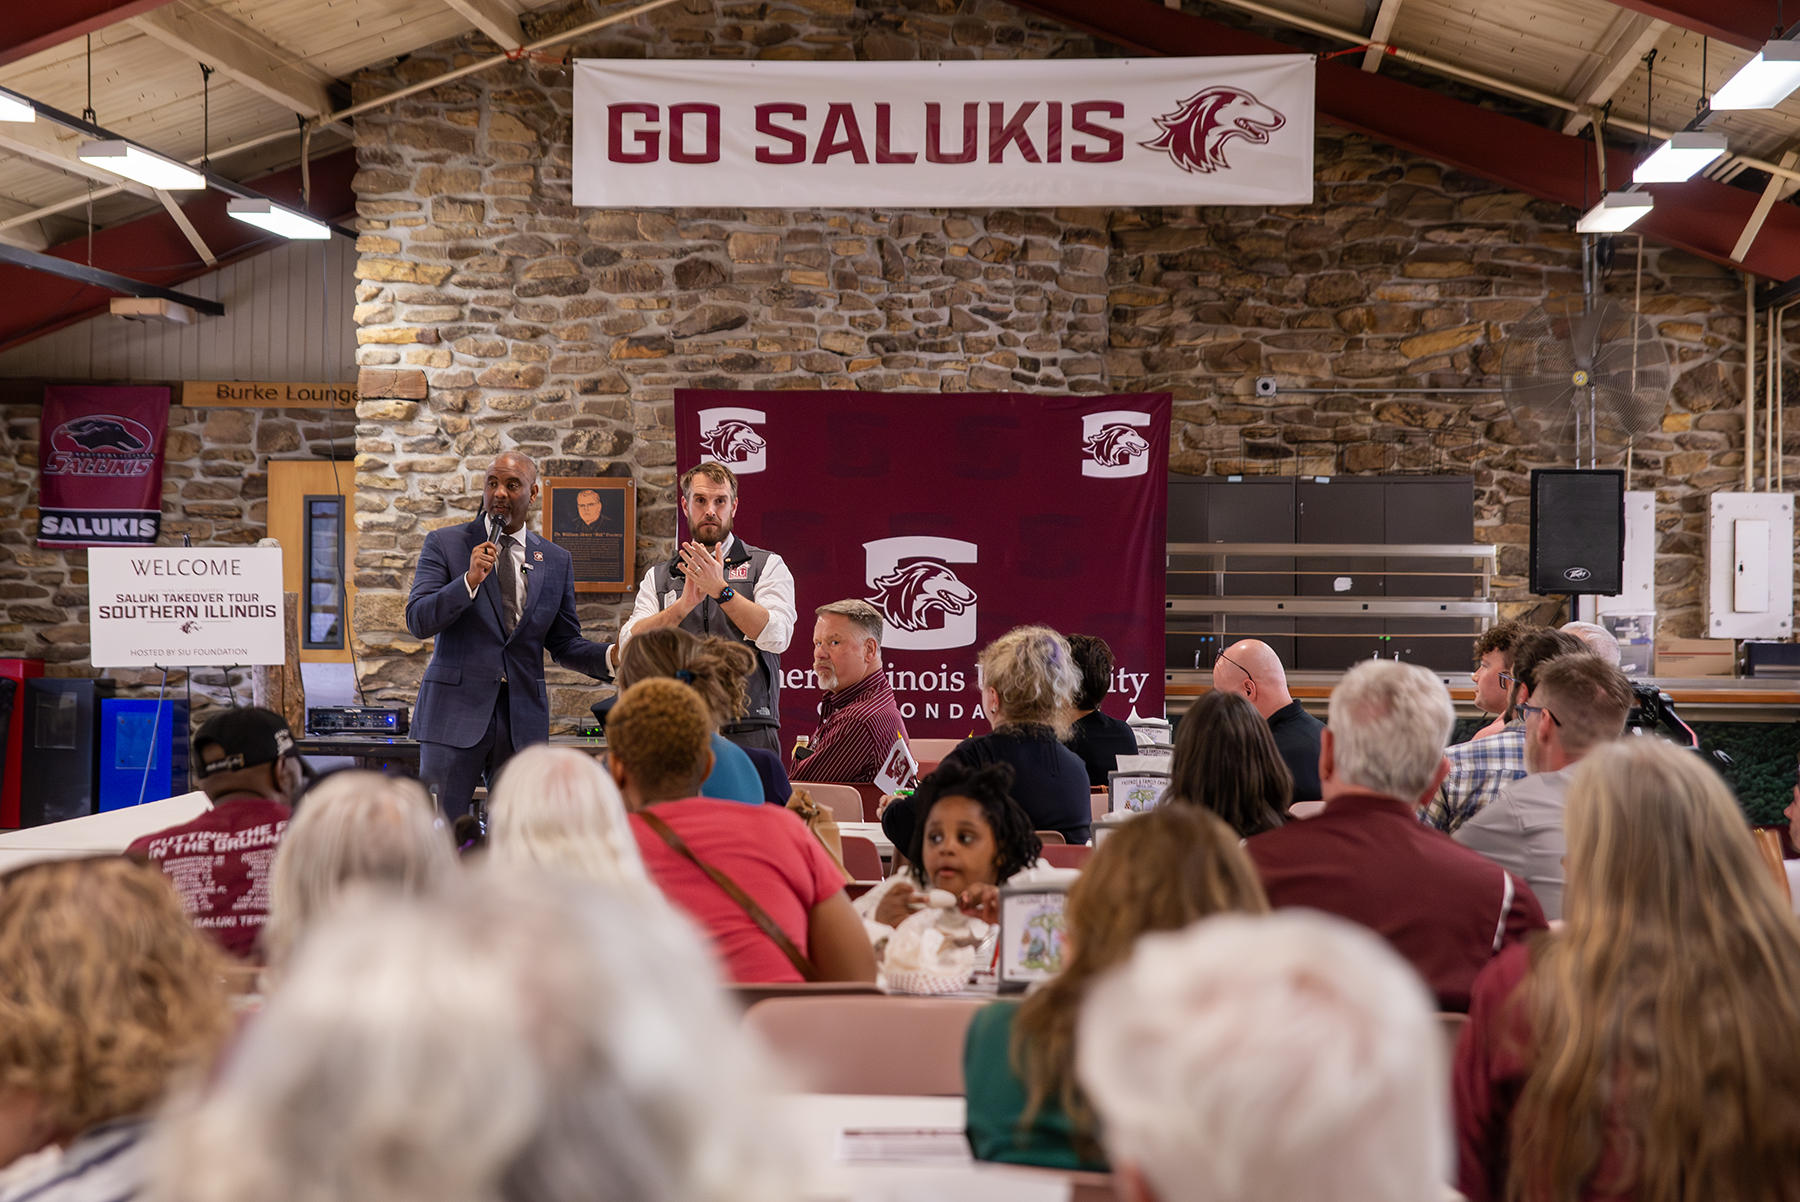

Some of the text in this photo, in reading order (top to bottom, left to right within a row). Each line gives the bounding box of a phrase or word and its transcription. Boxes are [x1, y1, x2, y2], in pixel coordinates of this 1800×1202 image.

[606, 101, 1126, 165] GO SALUKIS
[216, 383, 278, 400] Burke
[43, 451, 154, 477] SALUKIS
[41, 516, 157, 538] SALUKIS
[131, 558, 242, 576] WELCOME
[116, 592, 260, 603] SALUKI TAKEOVER TOUR
[99, 604, 277, 619] SOUTHERN ILLINOIS
[130, 648, 248, 657] HOSTED BY SIU FOUNDATION
[886, 662, 966, 692] inois
[148, 834, 284, 860] IN THE GROUN
[149, 831, 230, 850] PUTTING
[235, 823, 273, 838] THE
